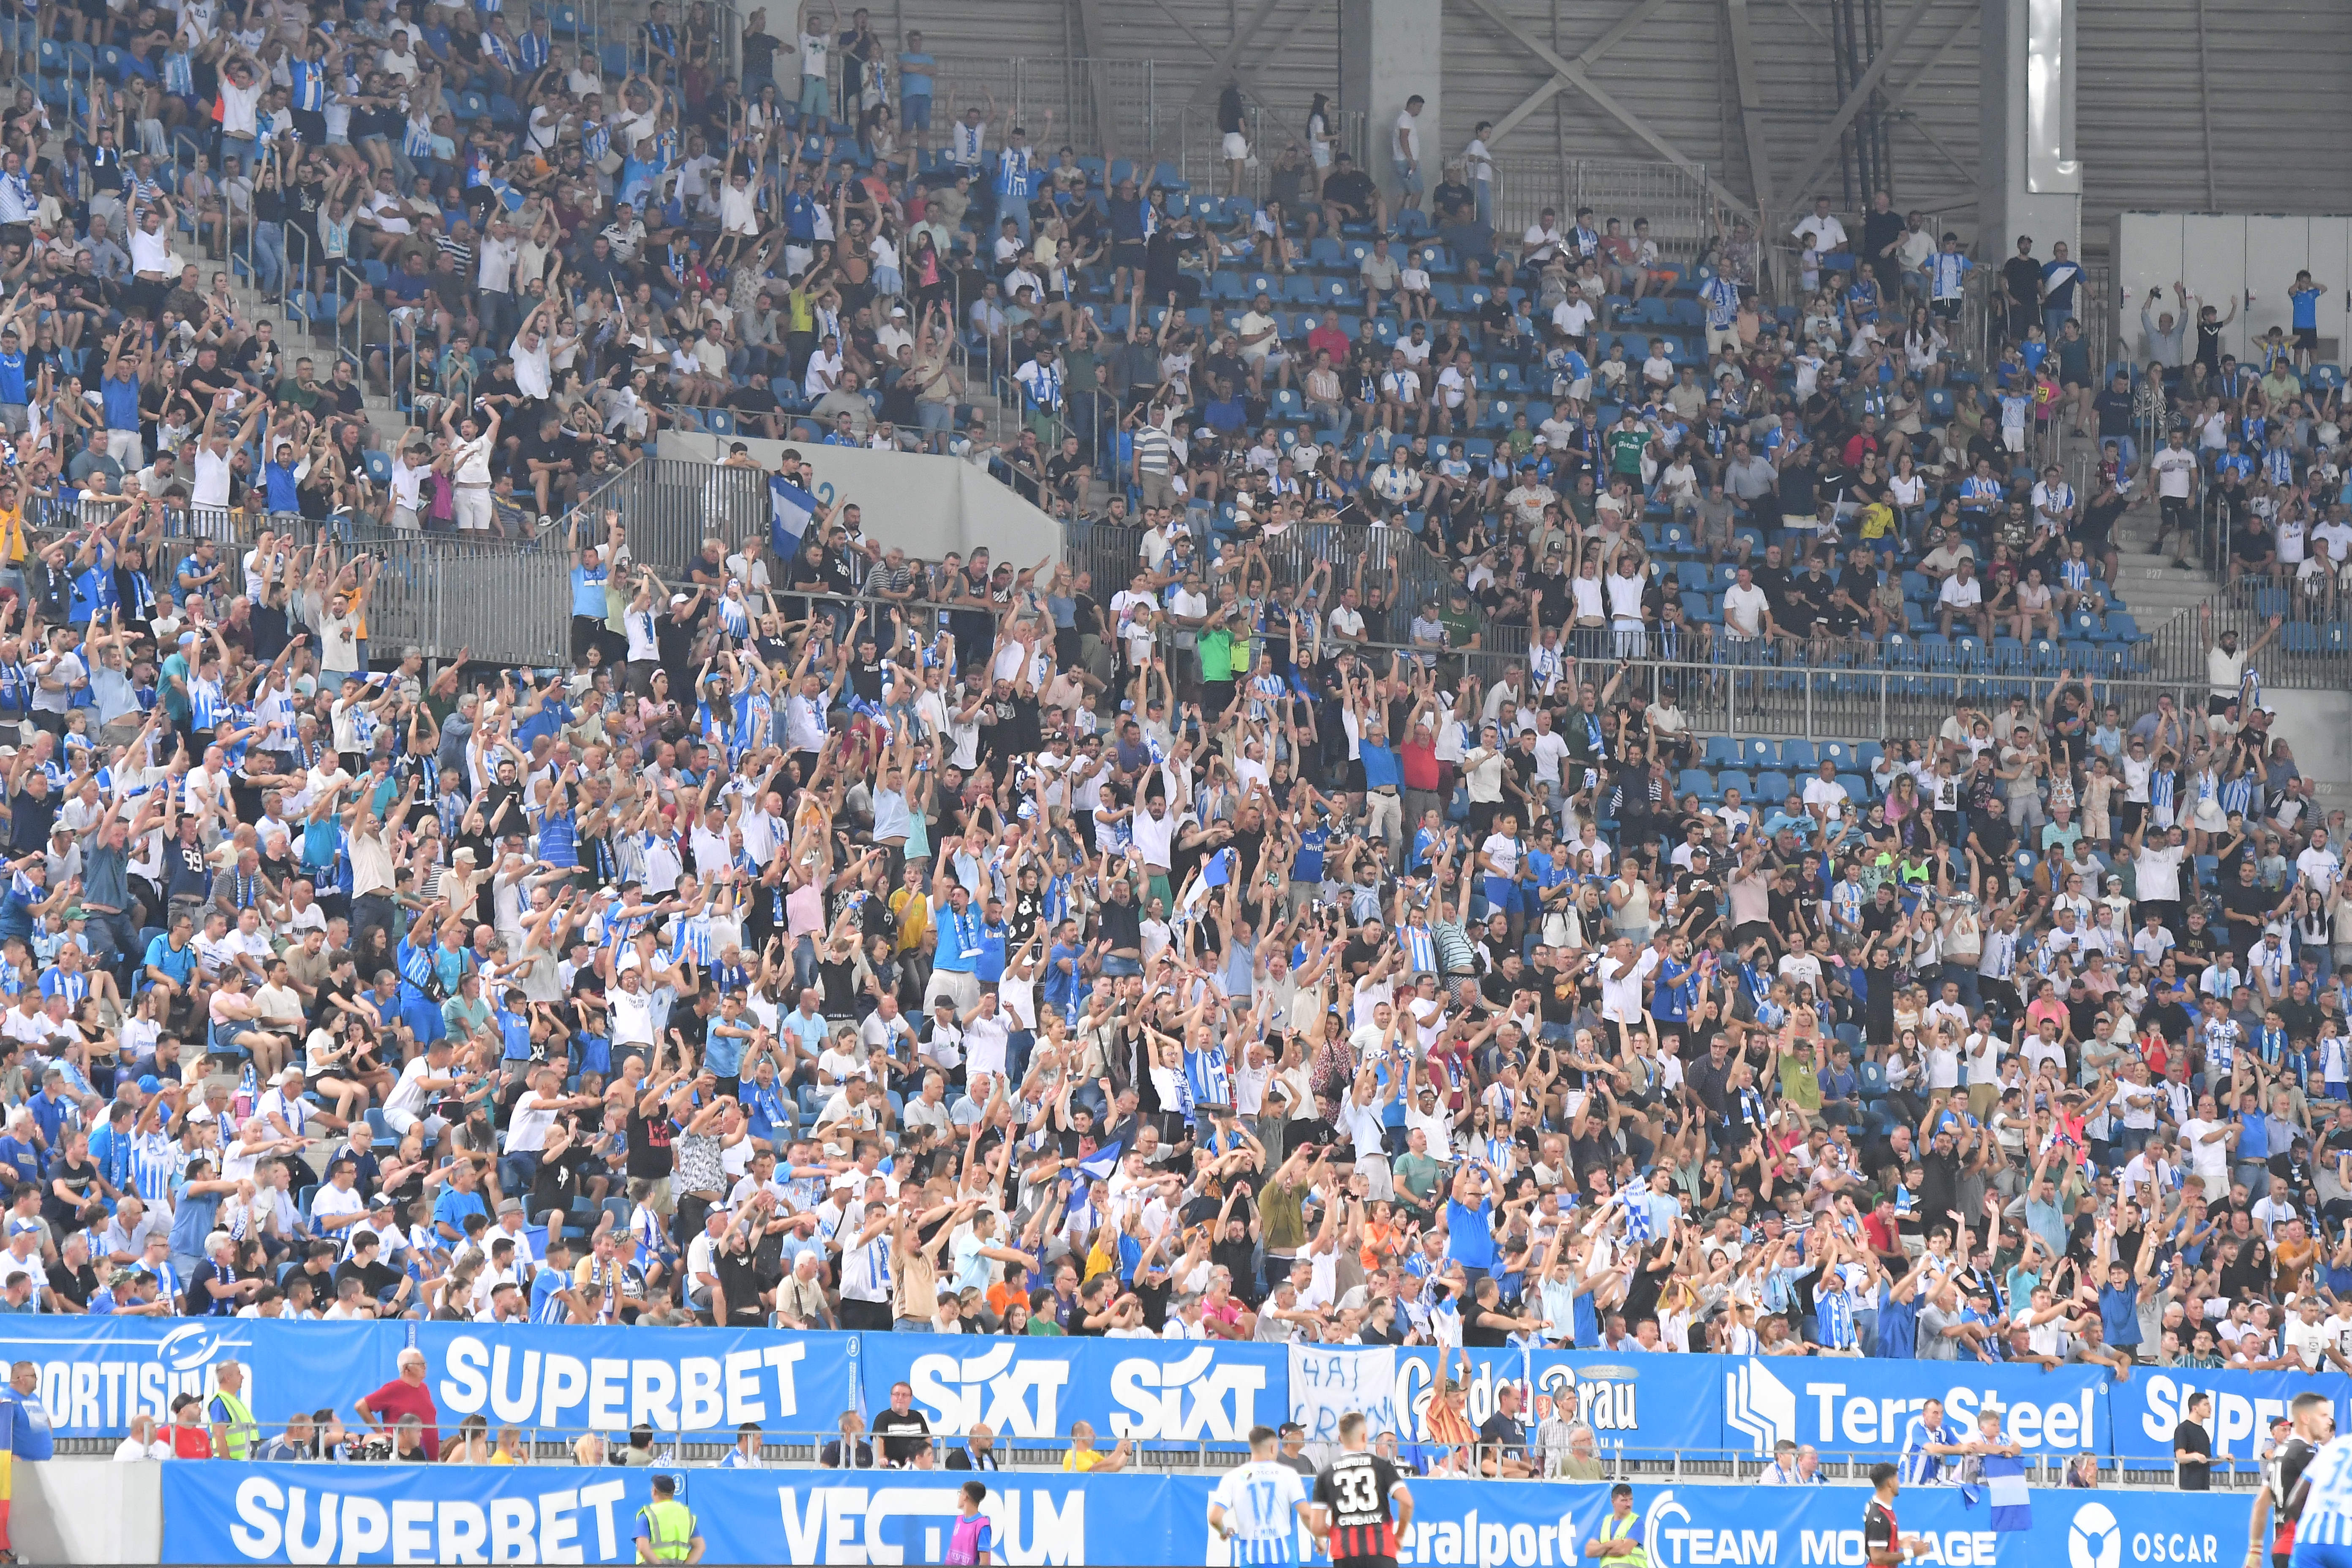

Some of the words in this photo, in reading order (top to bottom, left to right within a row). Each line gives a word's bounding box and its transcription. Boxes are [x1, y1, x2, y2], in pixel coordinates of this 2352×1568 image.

[1619, 441, 1640, 449] Betano
[2146, 569, 2162, 579] R27
[182, 849, 203, 873] 99
[0, 1360, 252, 1428] ORTISIM
[440, 1336, 806, 1431] SUPERBET
[1395, 1356, 1535, 1443] Gldn
[1294, 1396, 1395, 1441] CROV
[1247, 1481, 1275, 1526] 17
[1333, 1467, 1379, 1514] 33
[230, 1477, 626, 1565] SUPERBET
[1338, 1514, 1383, 1526] CINEMAX
[1664, 1529, 1778, 1565] TEAM
[1800, 1530, 1997, 1566] MOAGE
[2132, 1533, 2218, 1563] OSCAR
